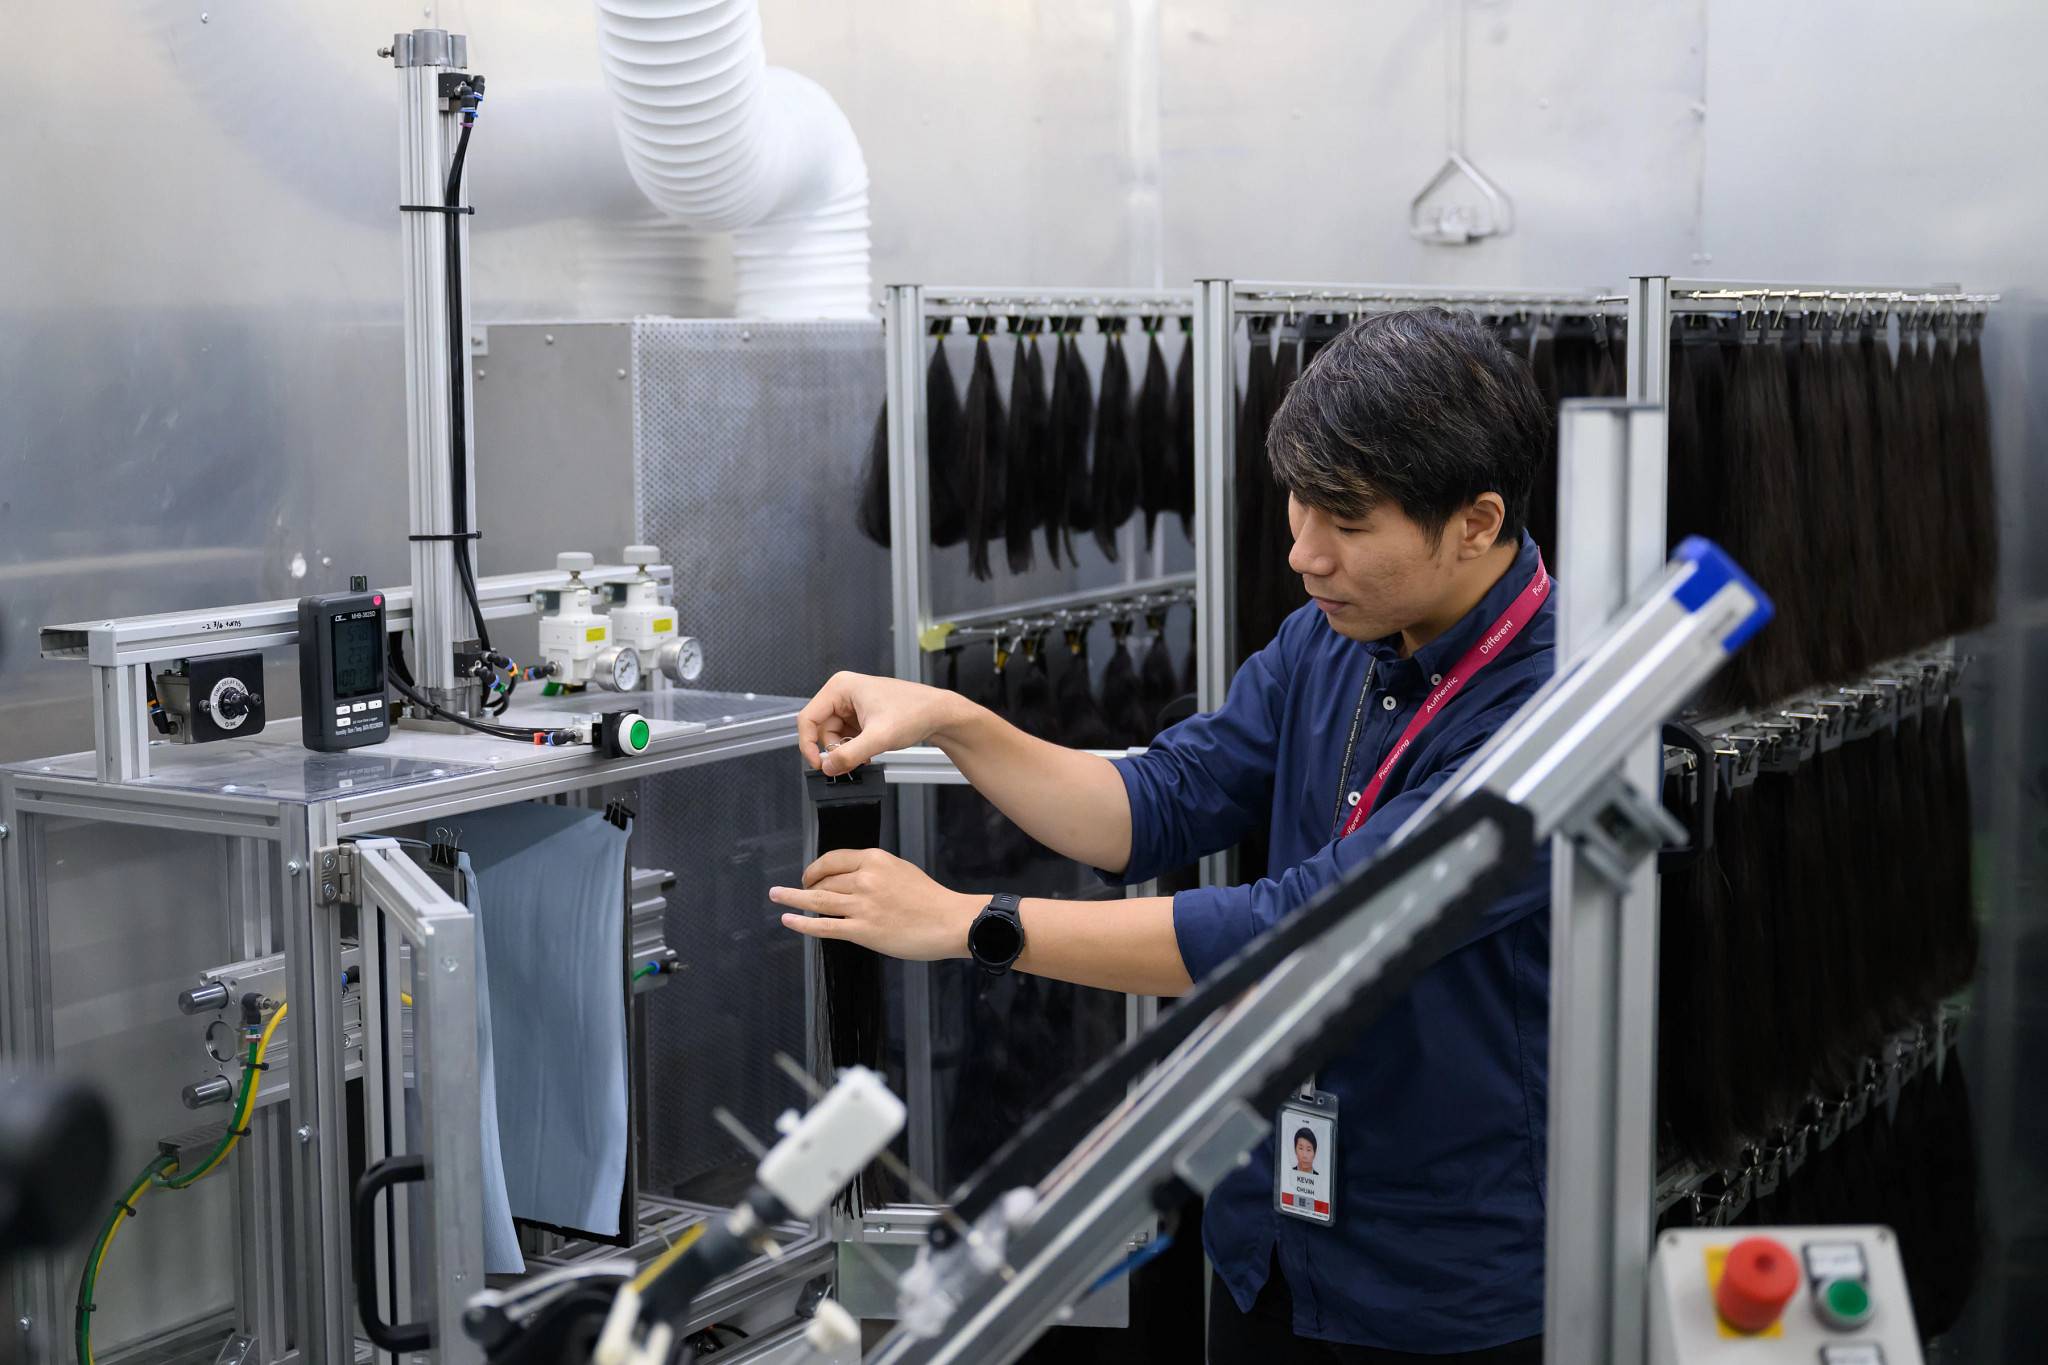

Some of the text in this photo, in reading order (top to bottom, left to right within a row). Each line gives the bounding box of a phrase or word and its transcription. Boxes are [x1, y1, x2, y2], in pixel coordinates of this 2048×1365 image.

[1479, 619, 1513, 655] Different
[1425, 676, 1458, 713] Authentic
[1378, 738, 1411, 781] Pioneering
[1296, 1175, 1315, 1186] KEVIN
